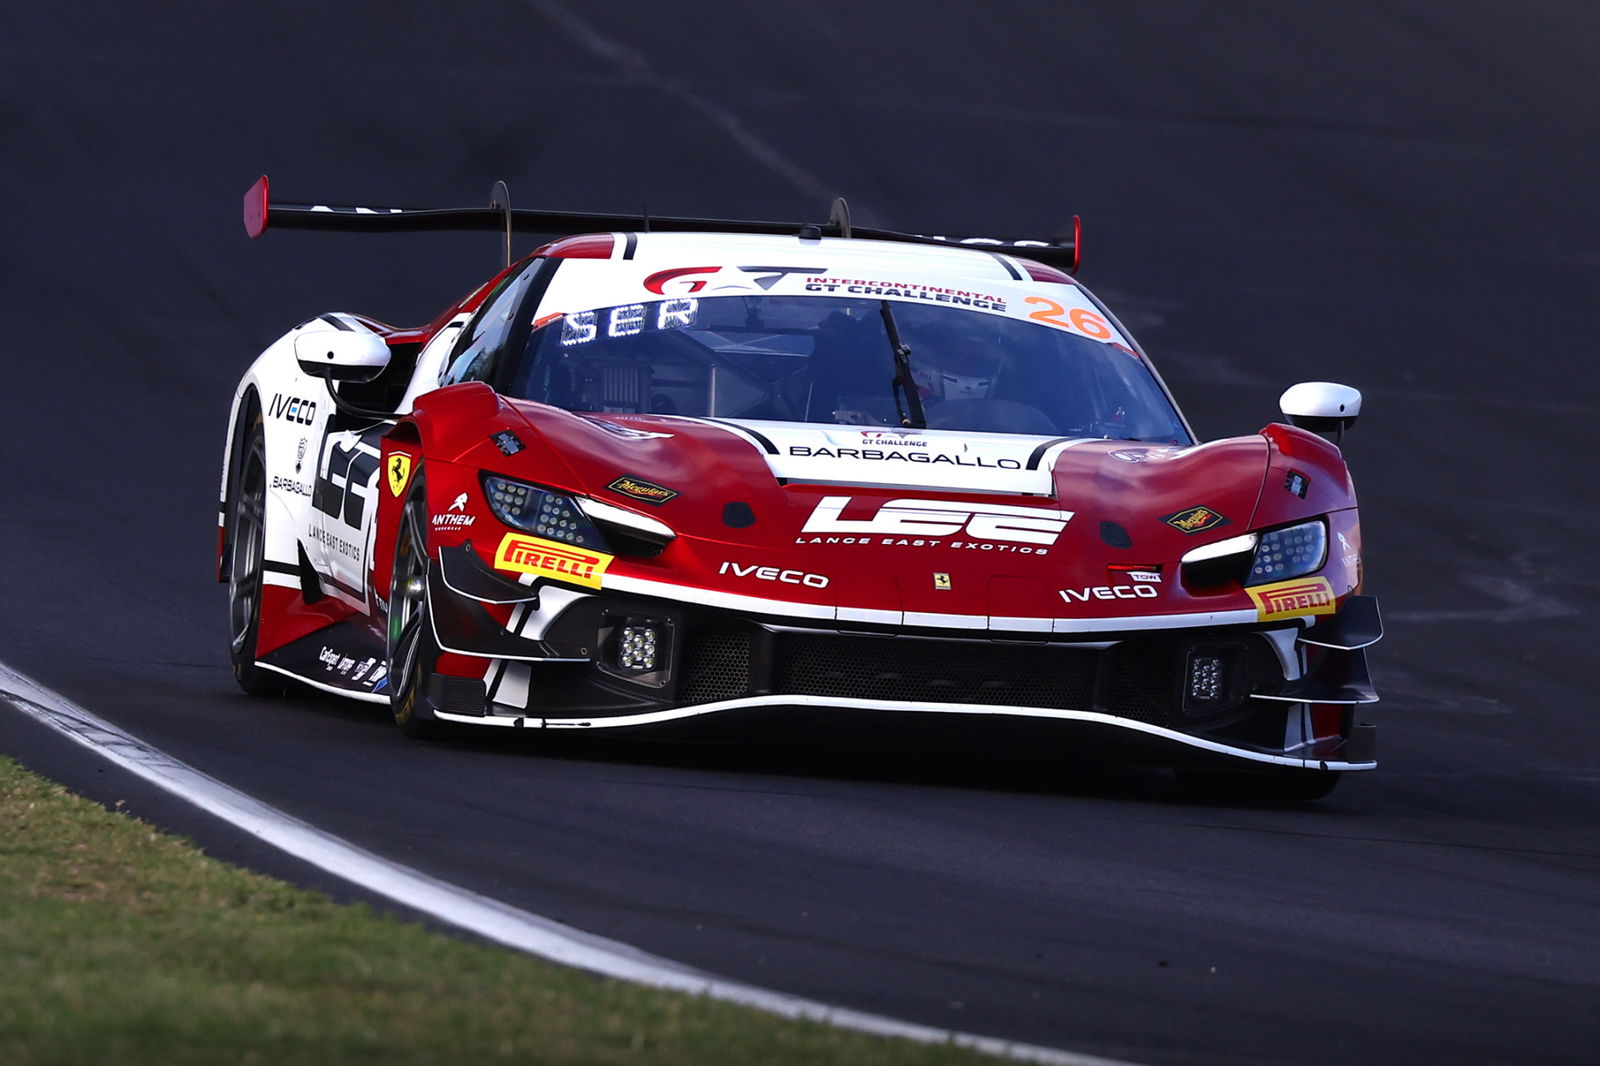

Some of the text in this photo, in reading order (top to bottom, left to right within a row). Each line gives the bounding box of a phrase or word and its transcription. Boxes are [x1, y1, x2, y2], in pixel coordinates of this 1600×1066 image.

[805, 284, 1007, 313] GT CHALLENGE
[806, 277, 1007, 303] INTERCONTINENTAL
[561, 298, 698, 346] SER
[1024, 296, 1112, 339] 26
[268, 393, 316, 426] IVECO
[876, 439, 928, 447] CHALLENGE
[789, 446, 1022, 470] BARBAGALLO
[273, 475, 313, 498] BARBAGALLO
[432, 513, 476, 527] ANTHEM
[800, 496, 1076, 546] LEE
[308, 524, 360, 562] LANCE EAST EXOTICS
[795, 536, 1049, 555] LANCE EAST EXOTICS
[503, 539, 600, 579] PIRELLI
[719, 561, 829, 589] IVECO
[1059, 584, 1158, 603] IVECO
[1257, 583, 1331, 615] PIRELLI
